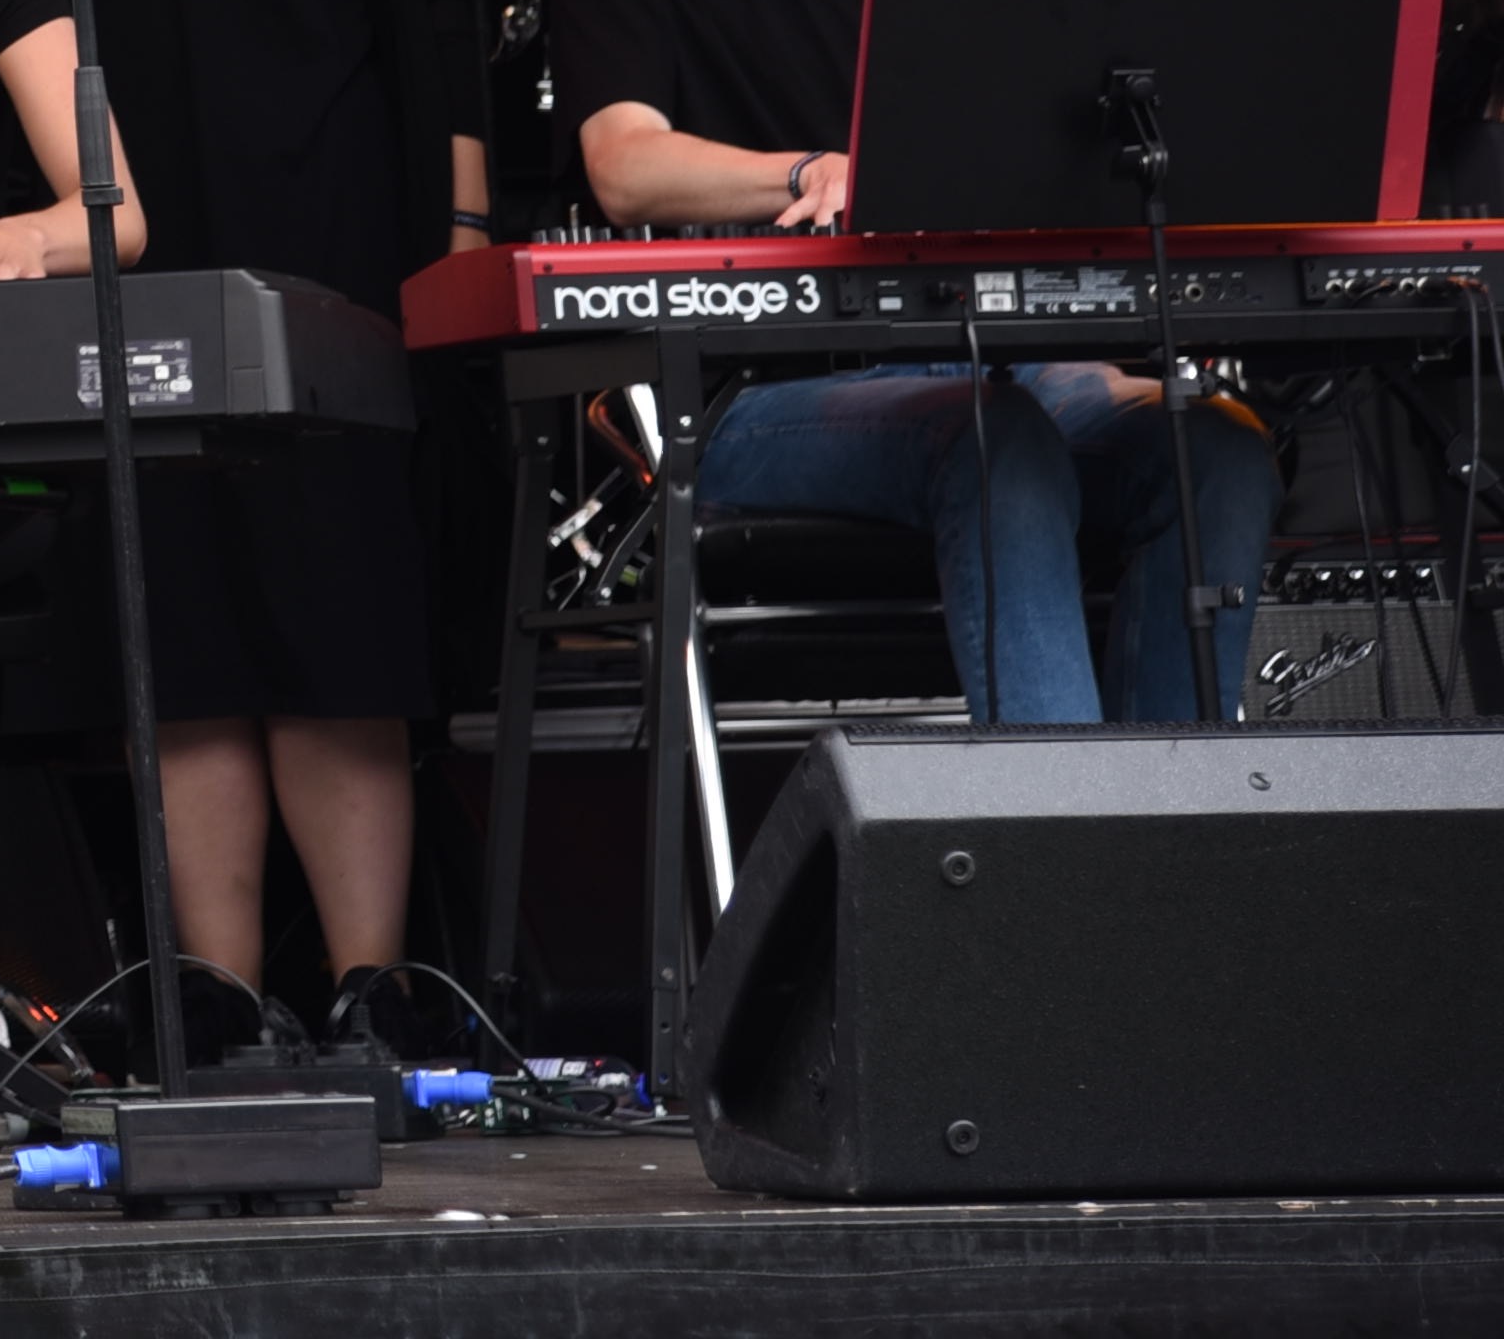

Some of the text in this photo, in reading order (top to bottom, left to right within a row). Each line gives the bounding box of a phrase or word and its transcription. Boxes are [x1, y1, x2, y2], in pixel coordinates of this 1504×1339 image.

[553, 274, 821, 322] nord stage 3
